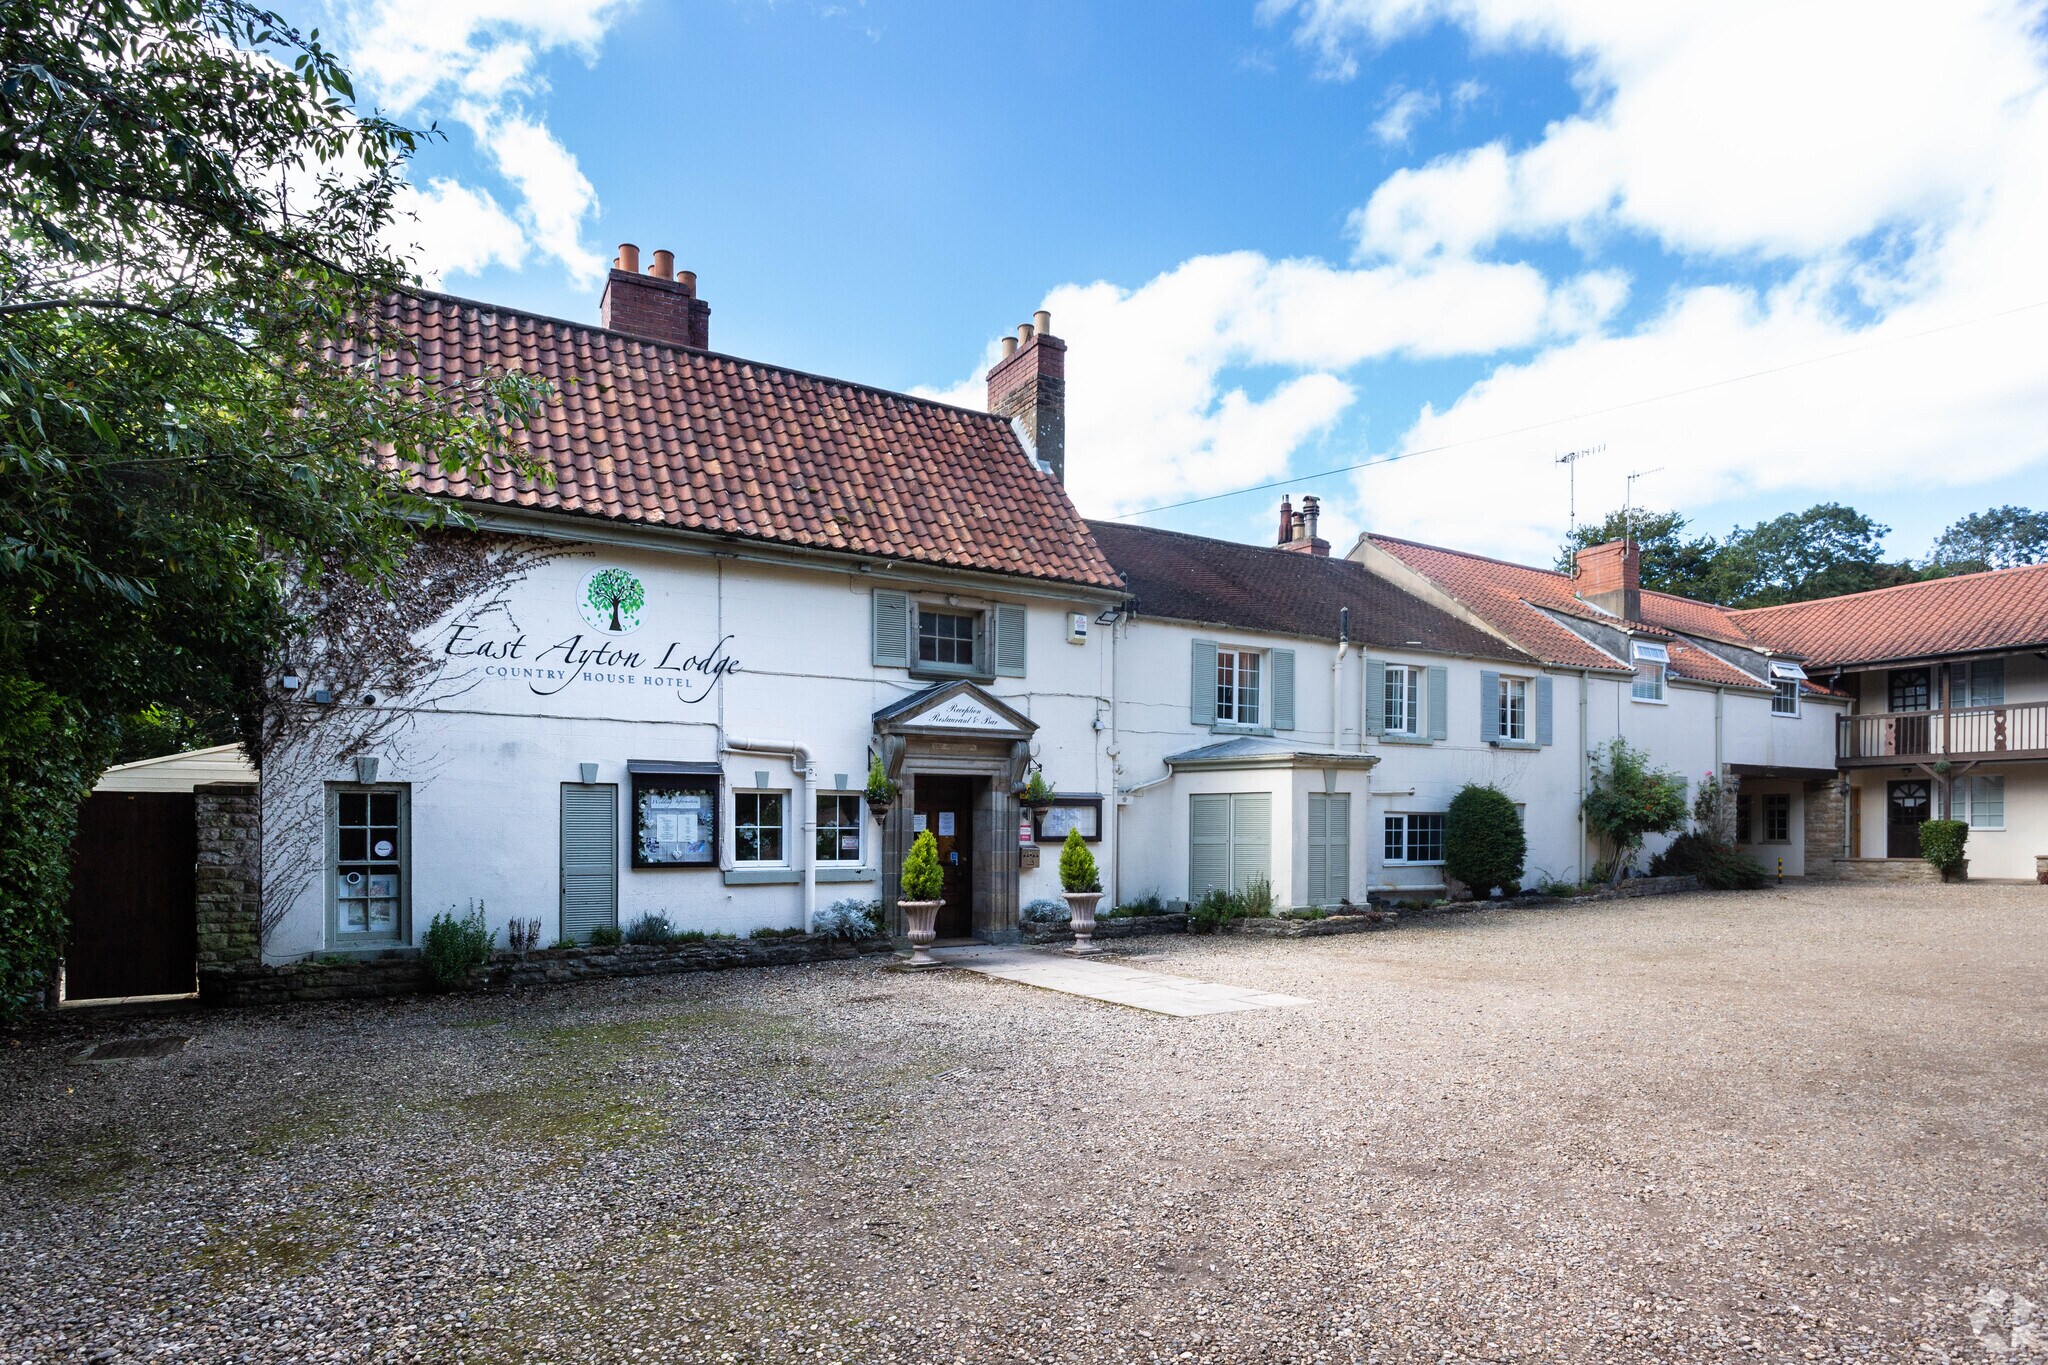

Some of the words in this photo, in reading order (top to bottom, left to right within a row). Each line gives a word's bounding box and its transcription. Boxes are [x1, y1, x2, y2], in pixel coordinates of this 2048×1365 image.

[444, 624, 527, 660] East
[529, 634, 646, 695] Ayton
[653, 634, 743, 704] Lodge
[485, 665, 566, 680] COUNTRY
[583, 672, 636, 685] HOUSE
[644, 676, 693, 688] HOTEL
[946, 703, 982, 715] Reception
[928, 712, 971, 724] Restaurant
[973, 716, 979, 724] &
[980, 716, 999, 726] Bar
[651, 798, 673, 808] Wedding
